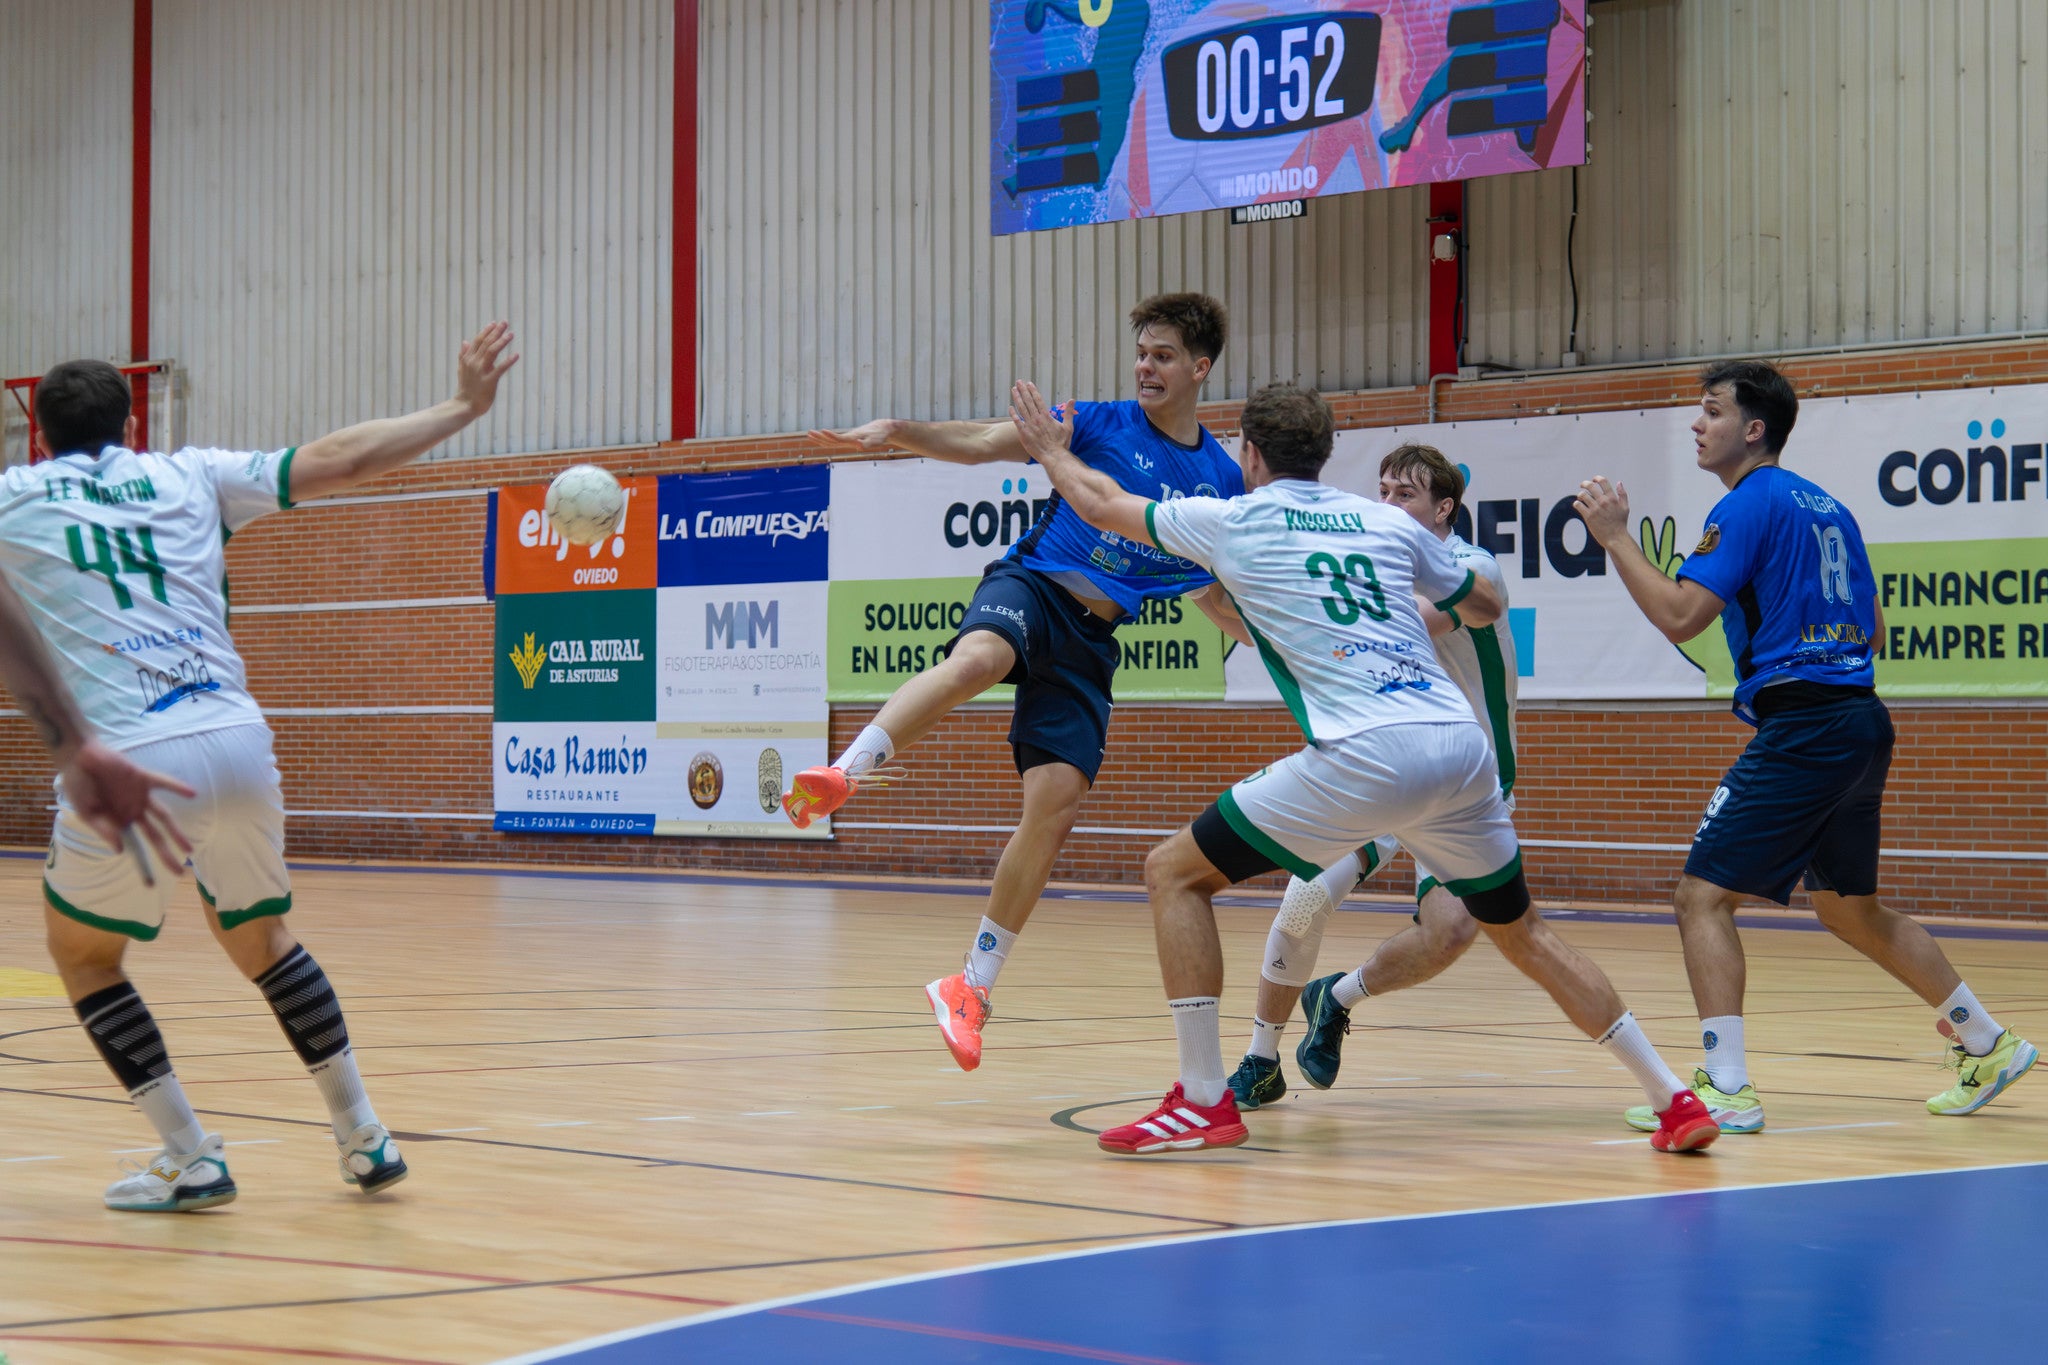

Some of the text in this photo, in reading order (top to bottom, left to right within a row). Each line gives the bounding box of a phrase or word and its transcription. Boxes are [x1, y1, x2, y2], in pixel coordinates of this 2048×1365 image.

[1196, 21, 1346, 134] 00:52
[1236, 165, 1318, 197] MONDO
[1246, 200, 1302, 222] MONDO
[659, 514, 688, 541] LA
[64, 522, 170, 611] 44
[573, 567, 618, 585] OVIEDO
[1305, 552, 1392, 625] 33
[550, 636, 644, 663] CAJA RURAL
[852, 646, 878, 673] EN
[885, 645, 926, 673] LAS
[550, 668, 618, 683] DE ASTURIAS
[505, 736, 557, 780] Casa
[565, 734, 648, 779] Ramón
[526, 788, 620, 802] RESTAURANTE
[514, 815, 636, 830] EL FONTÁN OVIEDO
